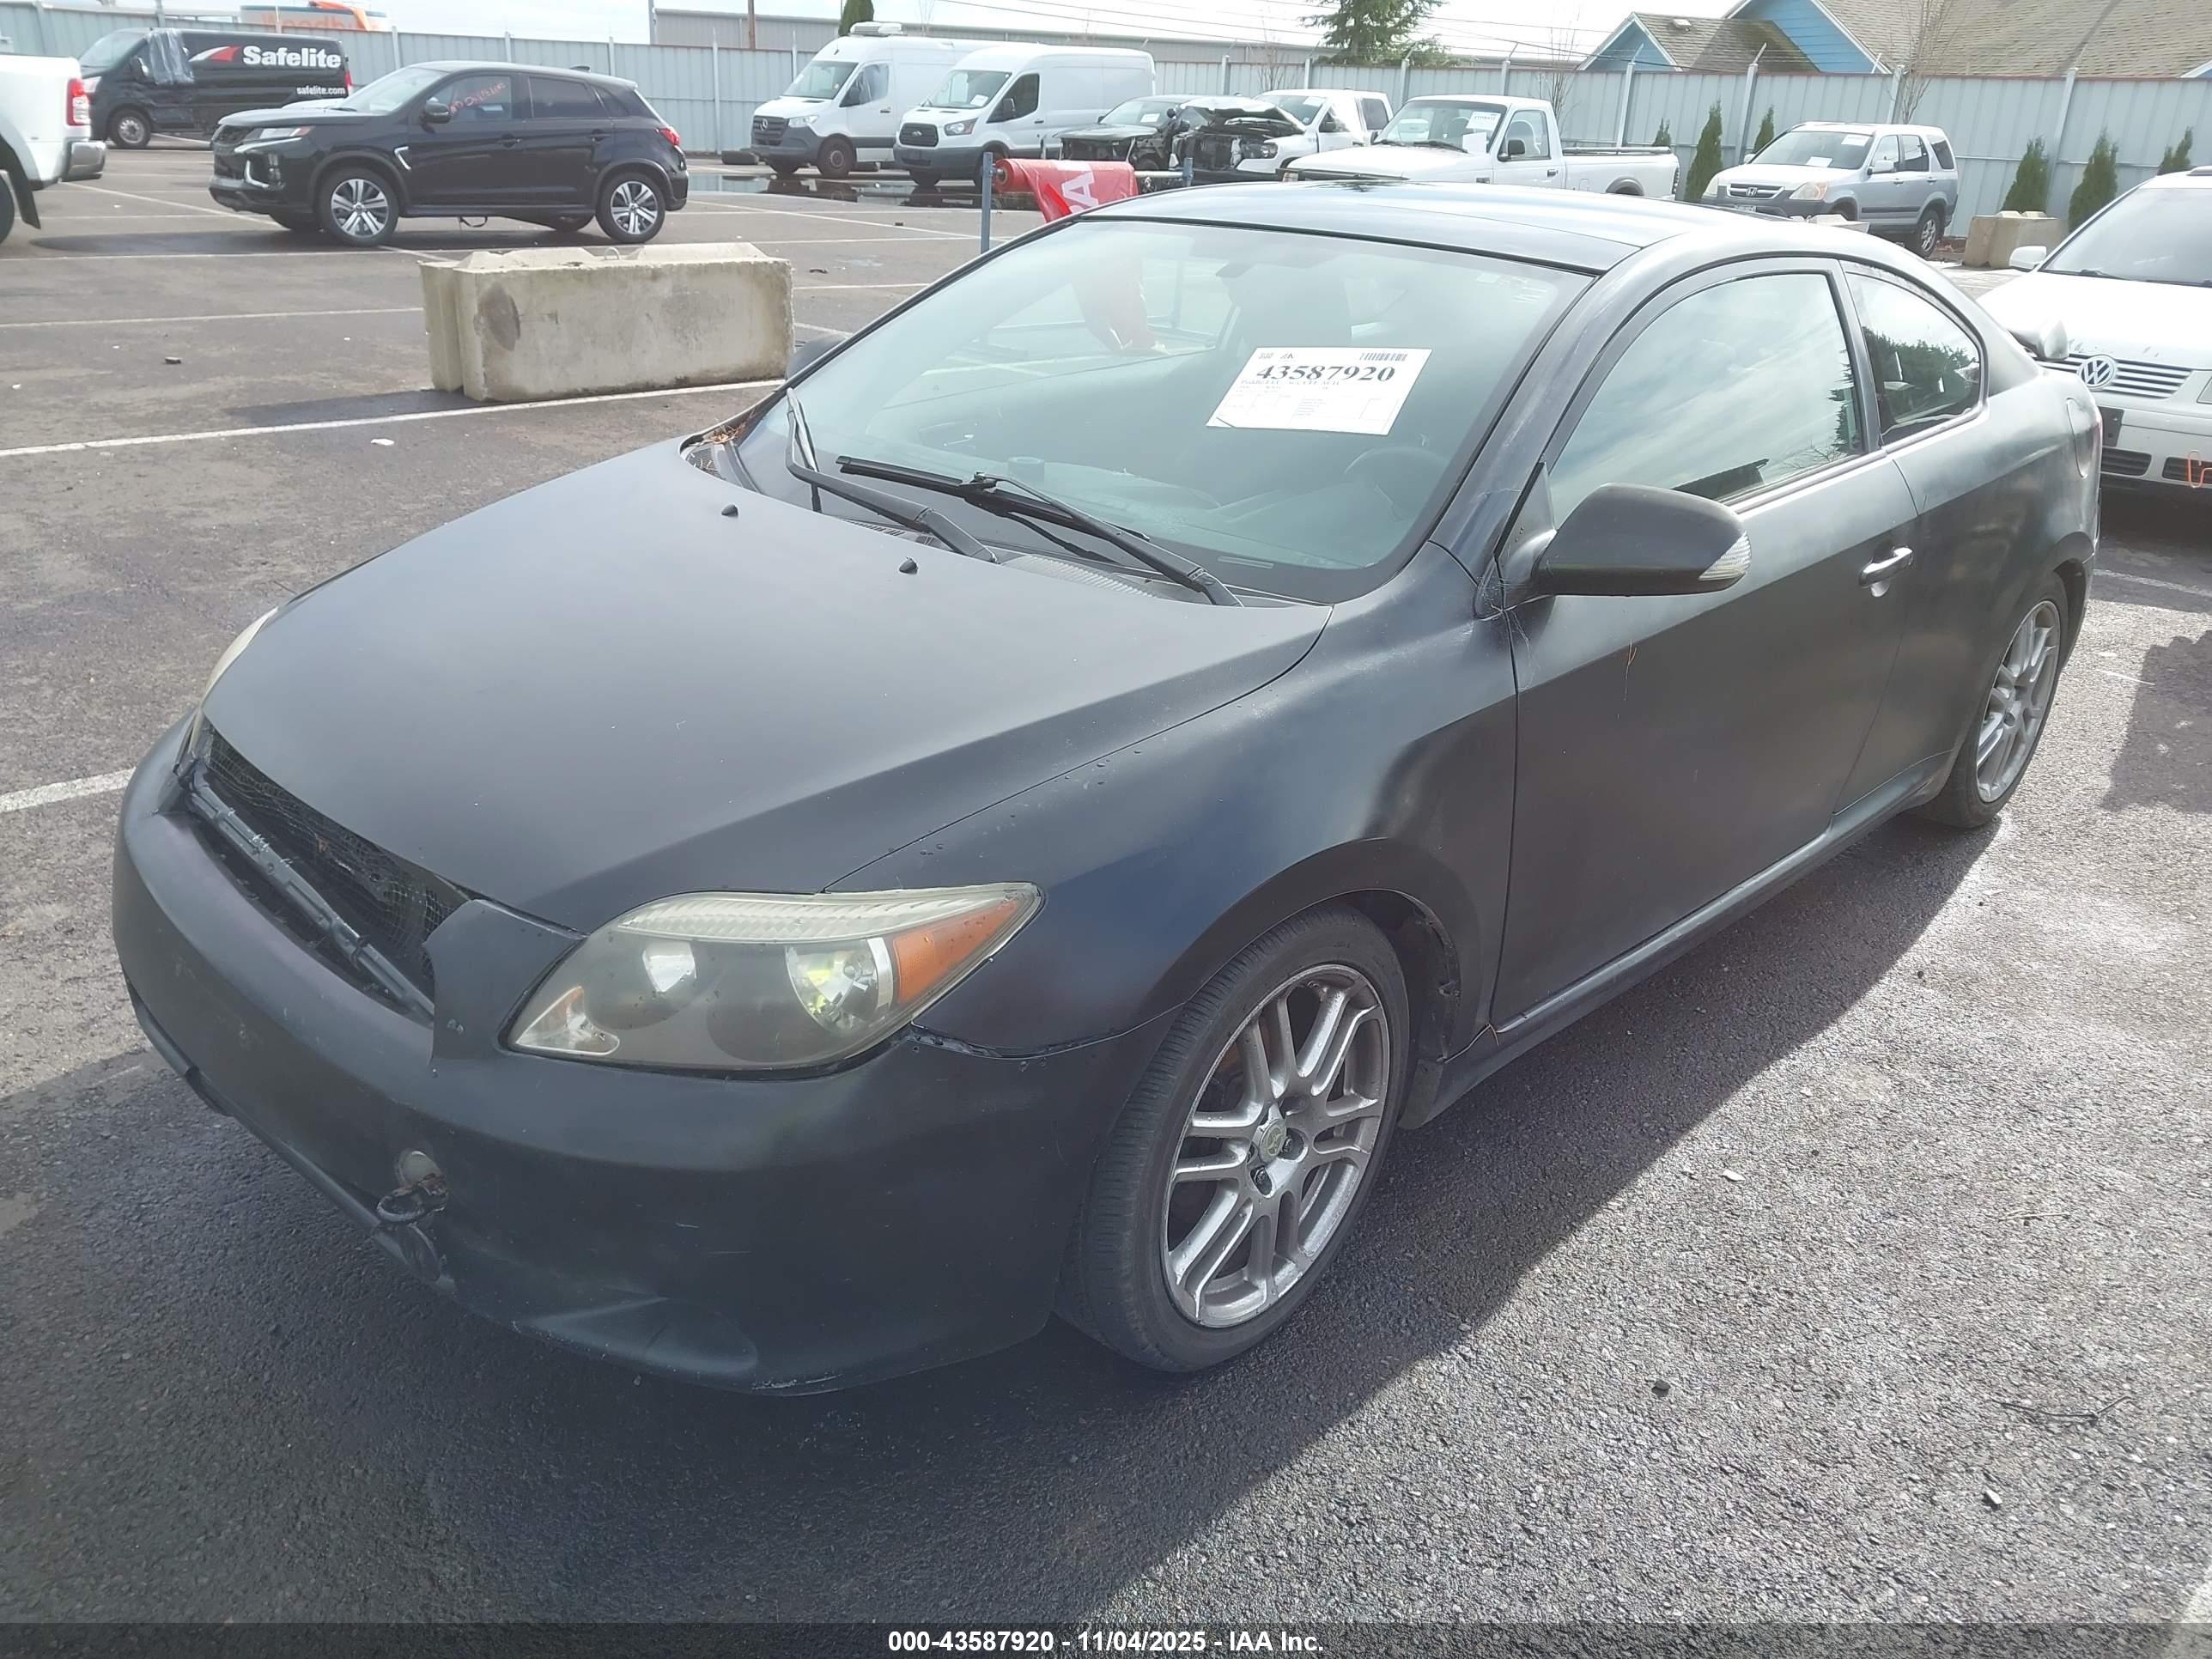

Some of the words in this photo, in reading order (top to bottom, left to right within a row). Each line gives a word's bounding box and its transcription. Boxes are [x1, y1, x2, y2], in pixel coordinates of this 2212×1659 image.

[243, 46, 342, 68] Safelite
[296, 85, 345, 95] safelite.com
[1256, 365, 1395, 382] 43587920
